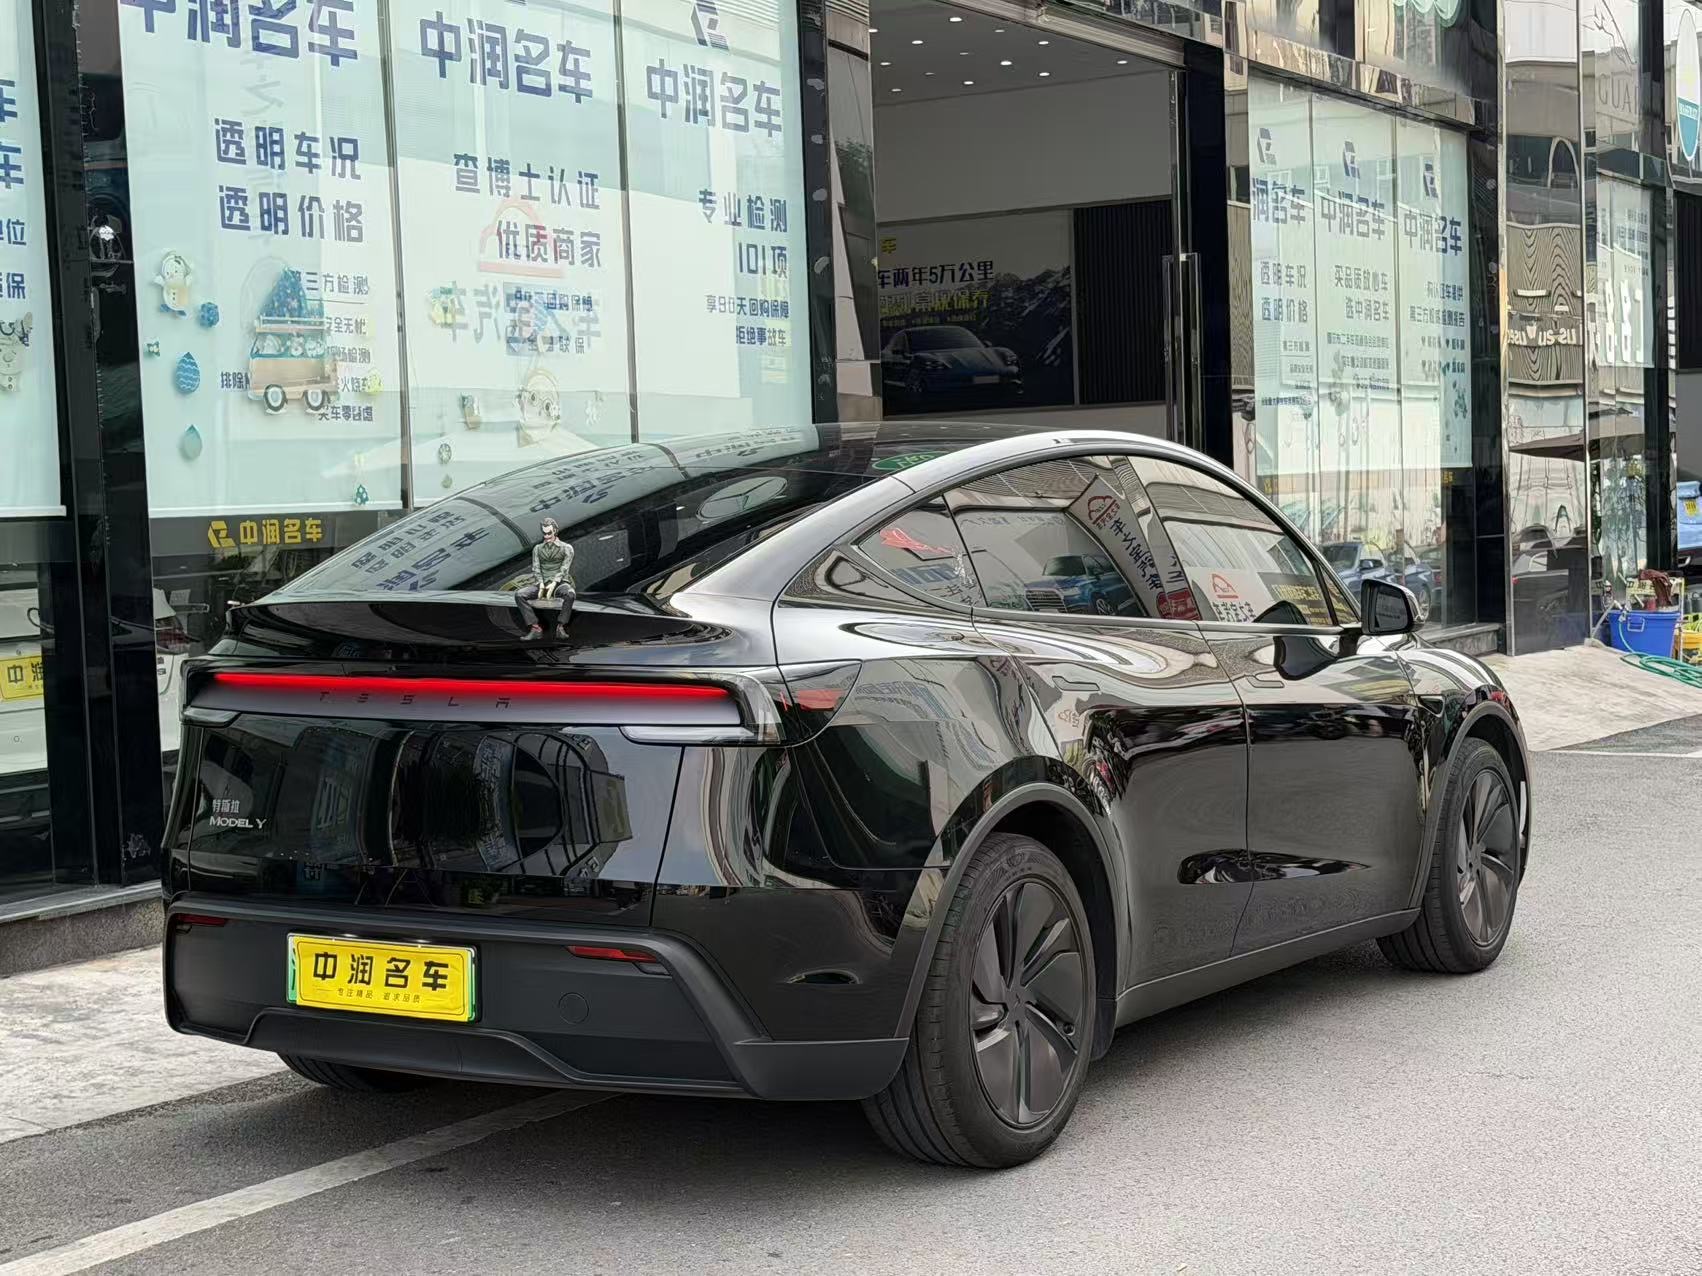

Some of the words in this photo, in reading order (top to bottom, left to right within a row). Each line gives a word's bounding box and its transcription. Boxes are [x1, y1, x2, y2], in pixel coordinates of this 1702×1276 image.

[420, 11, 593, 104] 中润名车
[646, 58, 783, 138] 中润名车
[214, 118, 361, 181] 透明车况
[454, 153, 600, 210] 查博士认证
[218, 185, 364, 243] 透明价格
[698, 188, 788, 233] 专业检测
[1320, 190, 1385, 240] 中润名车
[0, 217, 27, 246] 位
[496, 219, 601, 268] 优质商家
[1404, 210, 1462, 256] 中润名车
[738, 242, 788, 279] 101项
[1260, 261, 1307, 289] 透明车况
[0, 271, 27, 300] 保
[299, 270, 369, 295] 三方检测
[705, 293, 790, 320] 享90天回购保障
[1261, 297, 1308, 323] 透明价格
[735, 325, 788, 347] 拒绝事故车
[239, 518, 324, 544] 中润名车
[320, 691, 511, 709] TESLA
[209, 816, 253, 828] MODEL
[256, 818, 267, 829] Y
[212, 799, 240, 813] 特斯拉
[313, 951, 449, 991] 中润名车
